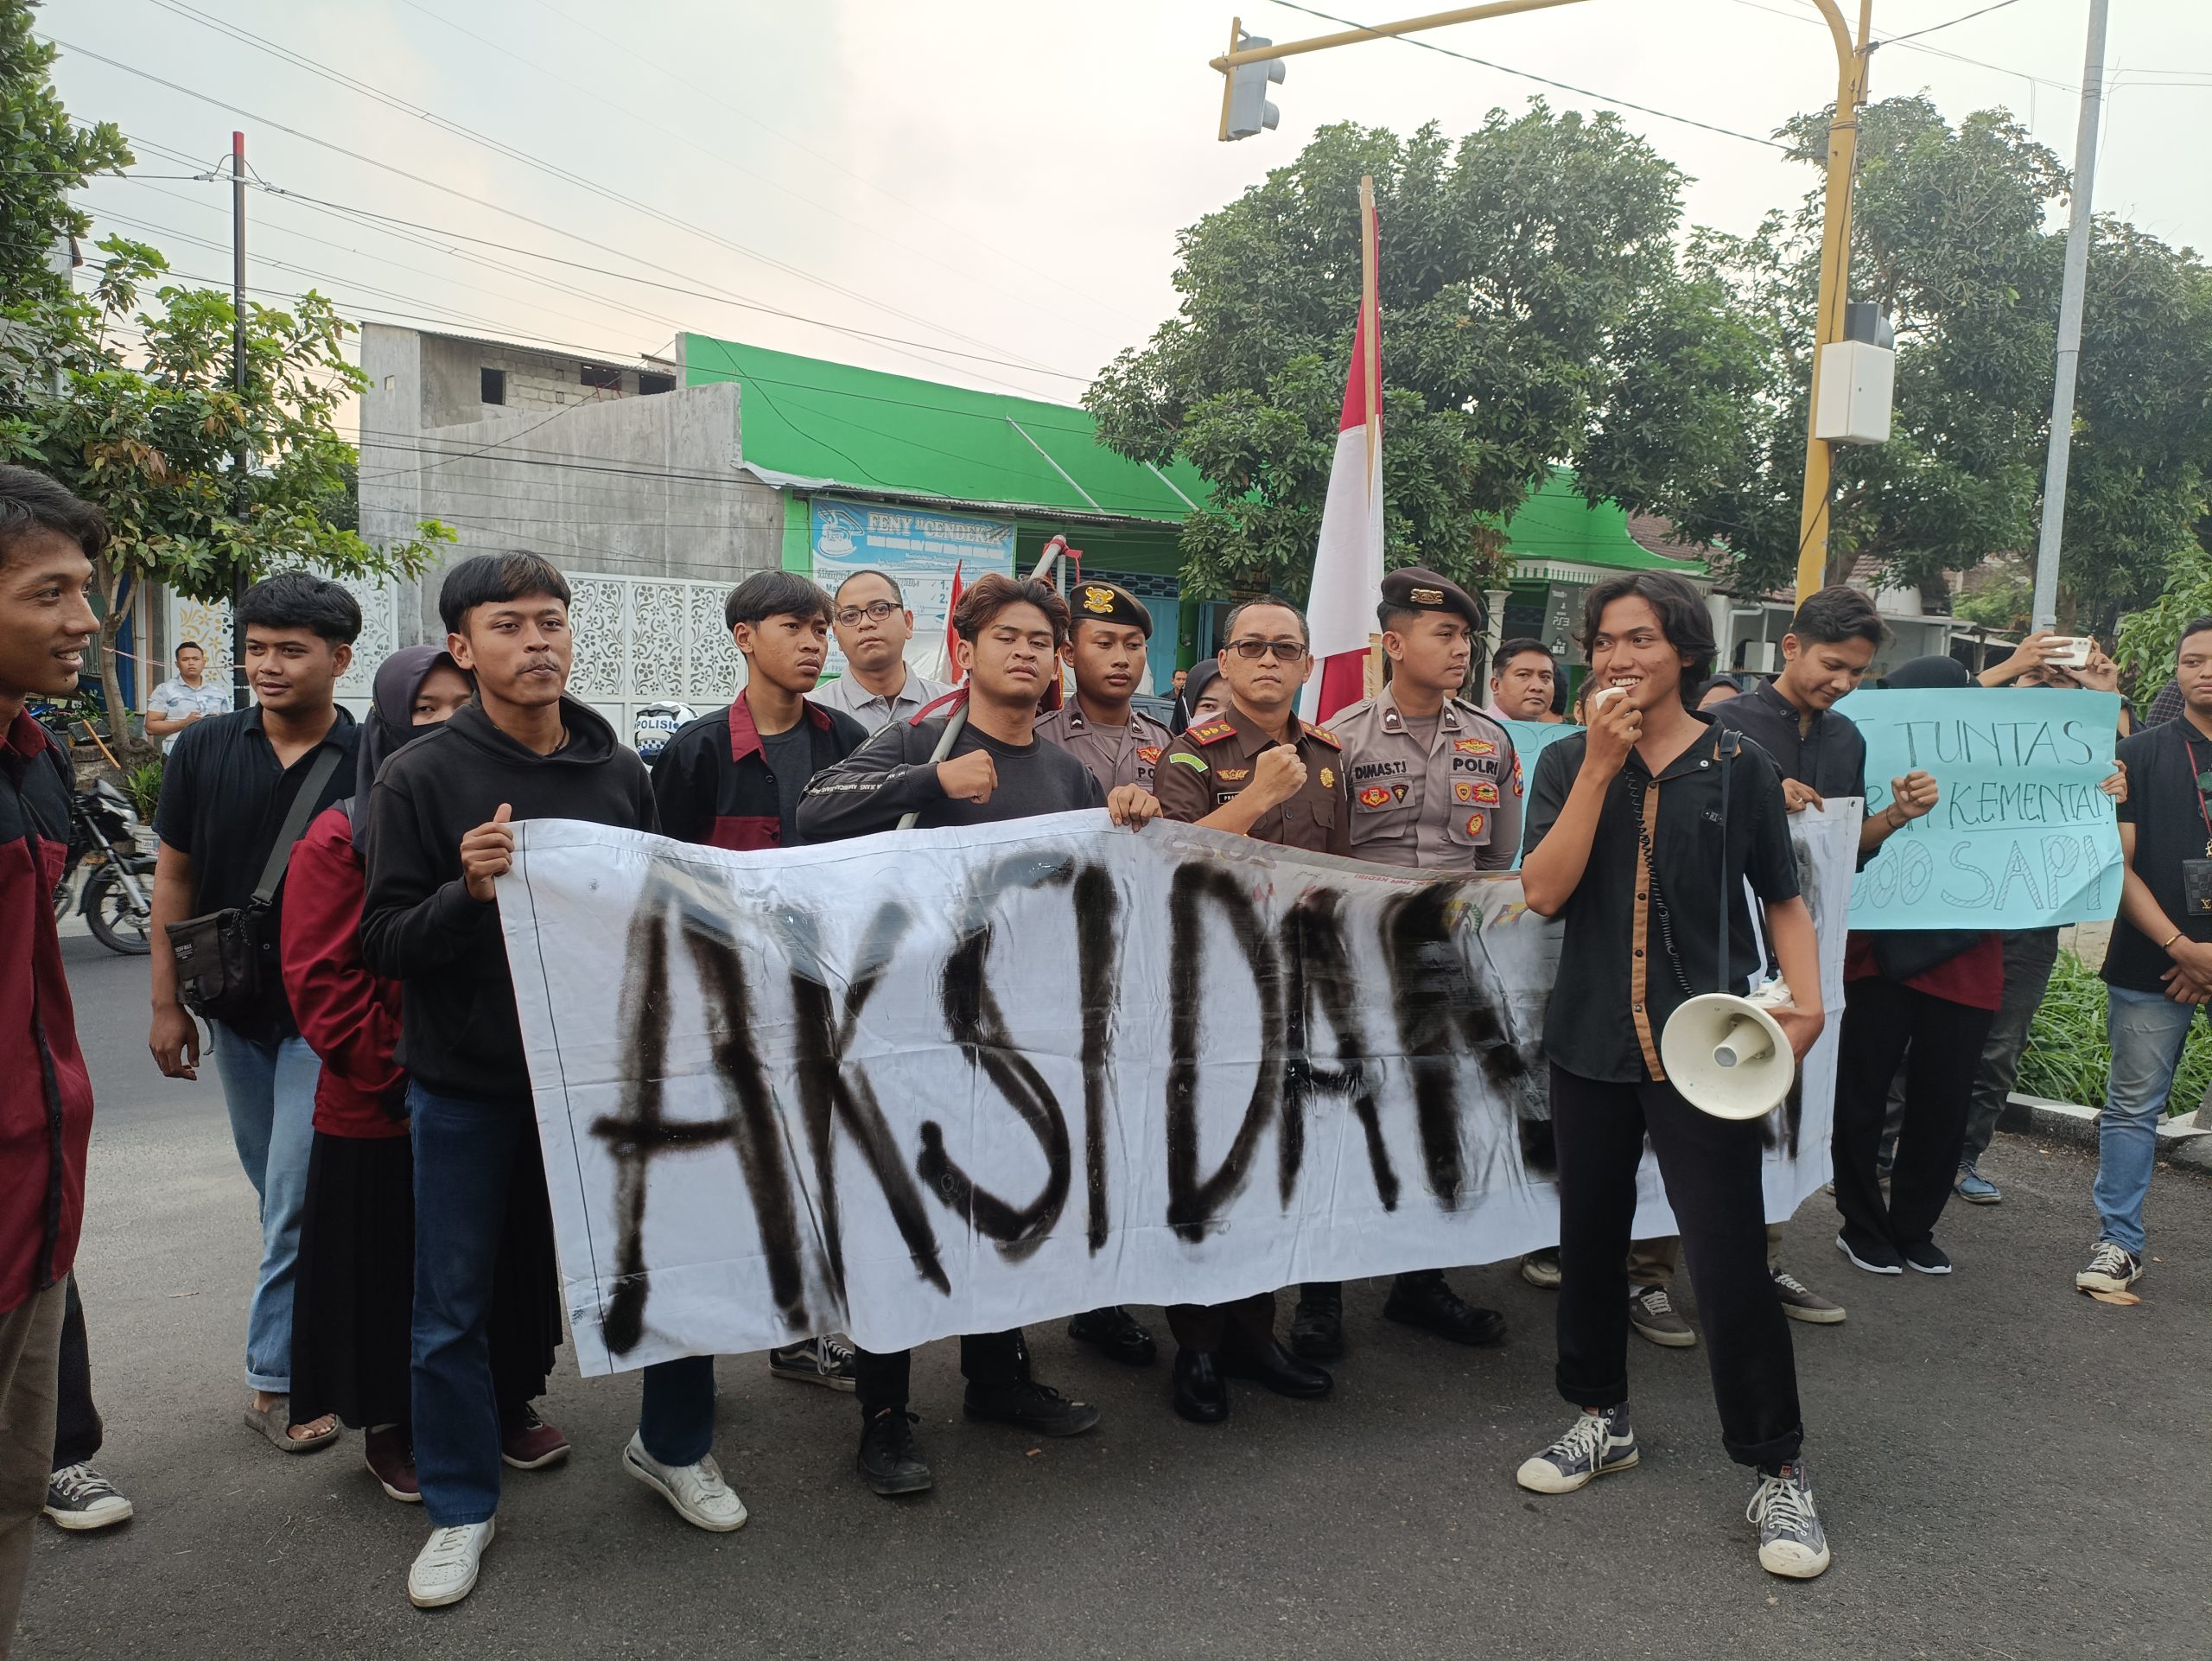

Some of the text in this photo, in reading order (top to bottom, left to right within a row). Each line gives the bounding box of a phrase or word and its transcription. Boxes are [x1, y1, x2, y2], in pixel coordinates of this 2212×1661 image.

[867, 511, 914, 536] FENY
[636, 719, 672, 730] POLISI
[1893, 720, 2094, 768] TUNTAS
[1354, 760, 1408, 779] DIMAS.TJ
[1452, 757, 1499, 776] POLRI
[1941, 834, 2103, 911] SAPI
[589, 850, 1122, 1355] AKSI
